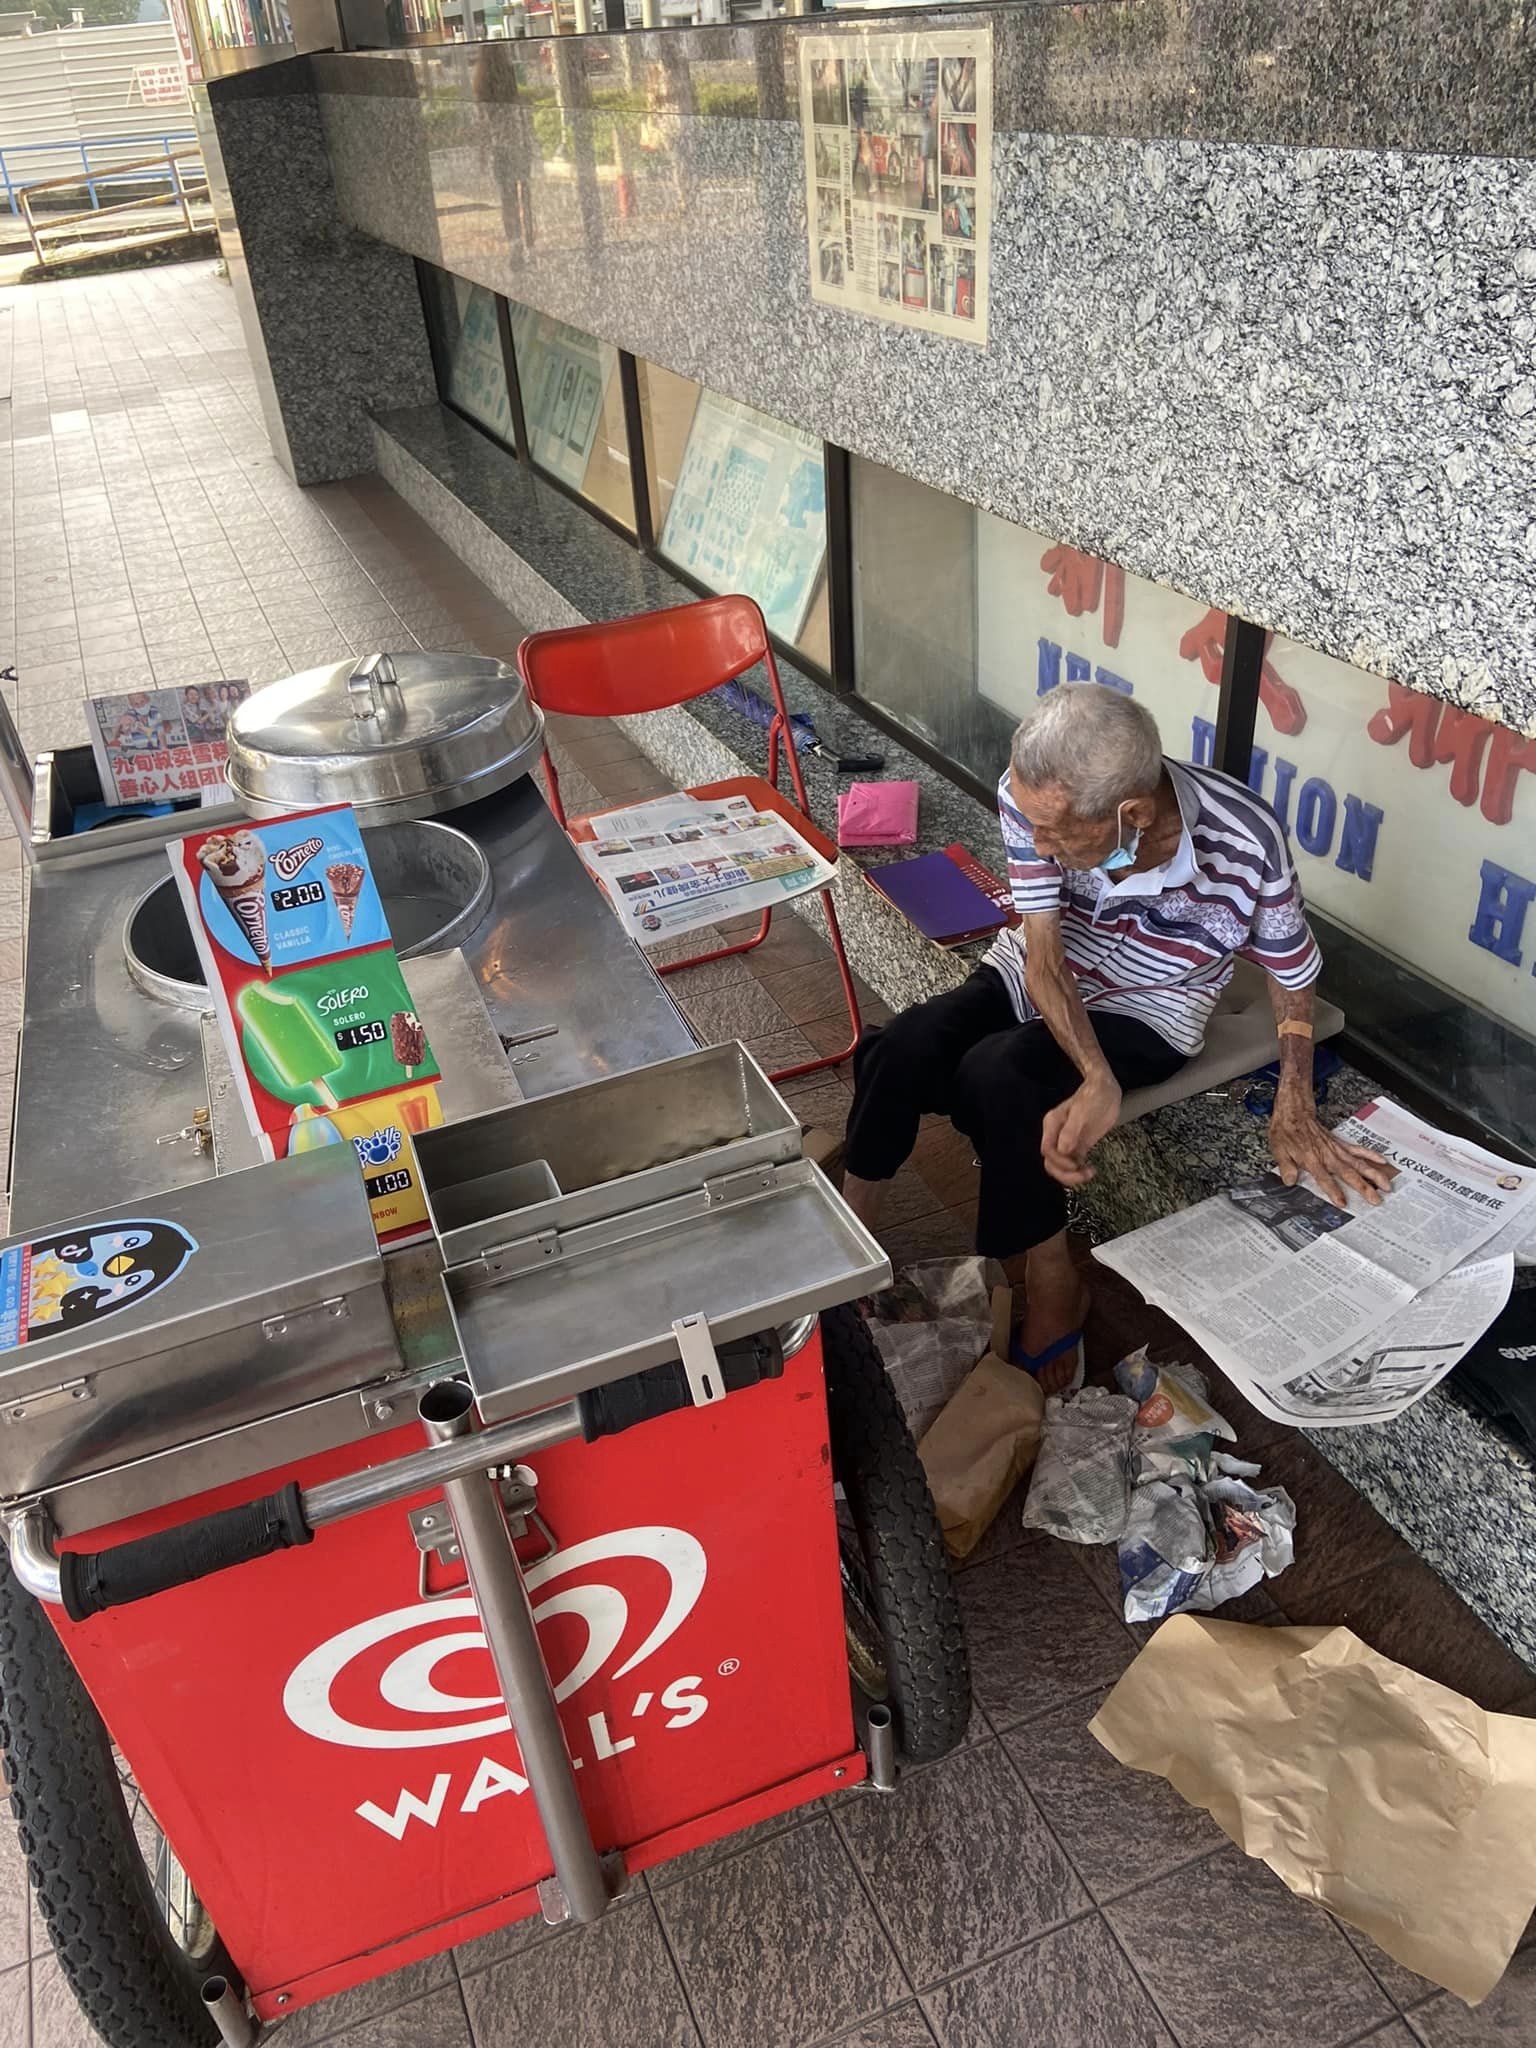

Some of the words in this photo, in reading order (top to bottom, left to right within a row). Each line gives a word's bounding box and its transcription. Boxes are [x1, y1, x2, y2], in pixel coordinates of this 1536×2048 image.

[118, 765, 227, 799] 善心人组团
[269, 837, 324, 881] Cornetto
[273, 926, 310, 941] CLASSIC
[275, 935, 312, 951] VANILLA
[317, 985, 369, 1017] SOLERO
[333, 1011, 366, 1026] SOLERO
[353, 1126, 401, 1152] Paddle
[367, 1170, 409, 1194] 1.00
[355, 1675, 709, 1840] WAL'S
